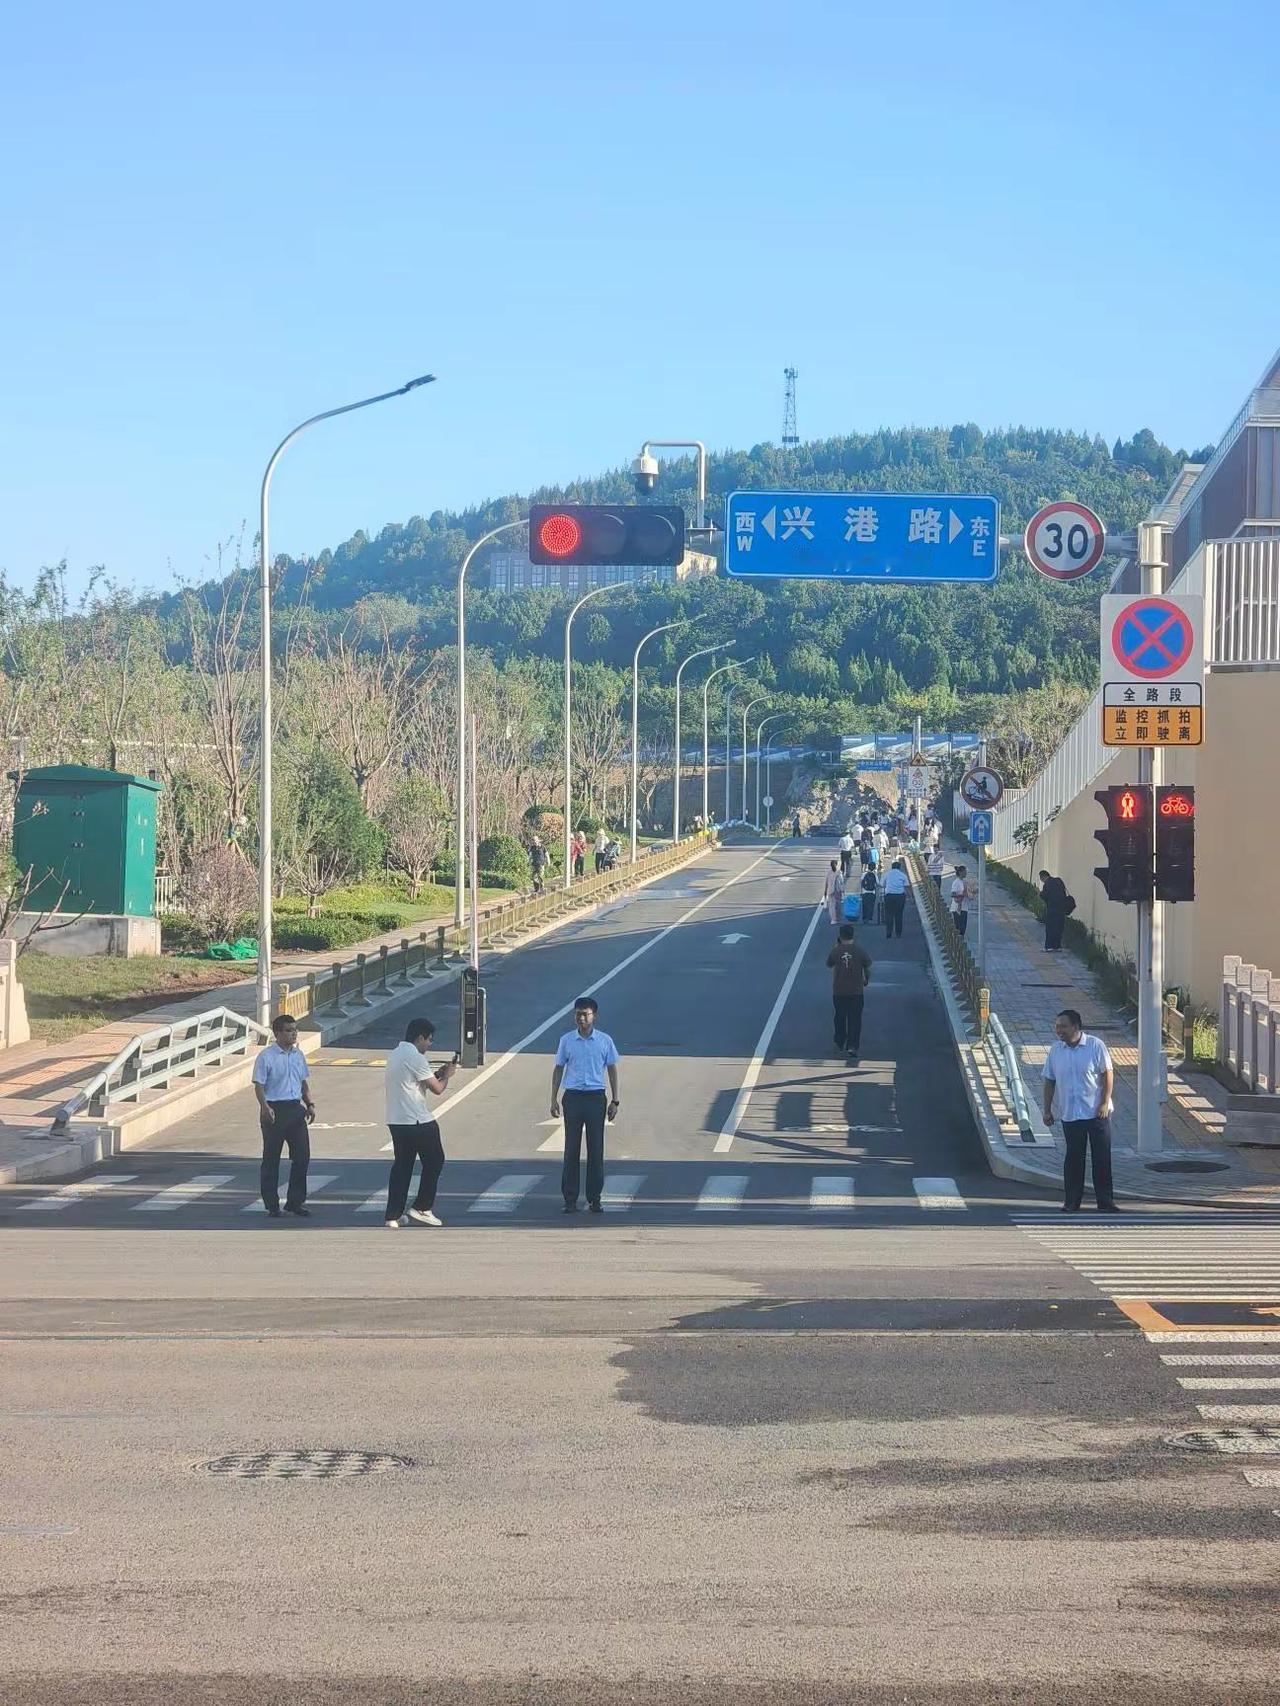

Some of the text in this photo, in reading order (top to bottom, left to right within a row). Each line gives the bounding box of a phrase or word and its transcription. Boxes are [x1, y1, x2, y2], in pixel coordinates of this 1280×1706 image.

[735, 511, 756, 533] 西
[781, 506, 944, 544] 兴港路
[970, 516, 990, 537] 东
[736, 537, 753, 552] W
[972, 539, 986, 556] E
[1042, 522, 1089, 560] 30
[1123, 687, 1182, 703] 全路段
[1115, 709, 1191, 724] 监控抓拍
[1115, 726, 1191, 741] 立即驶离
